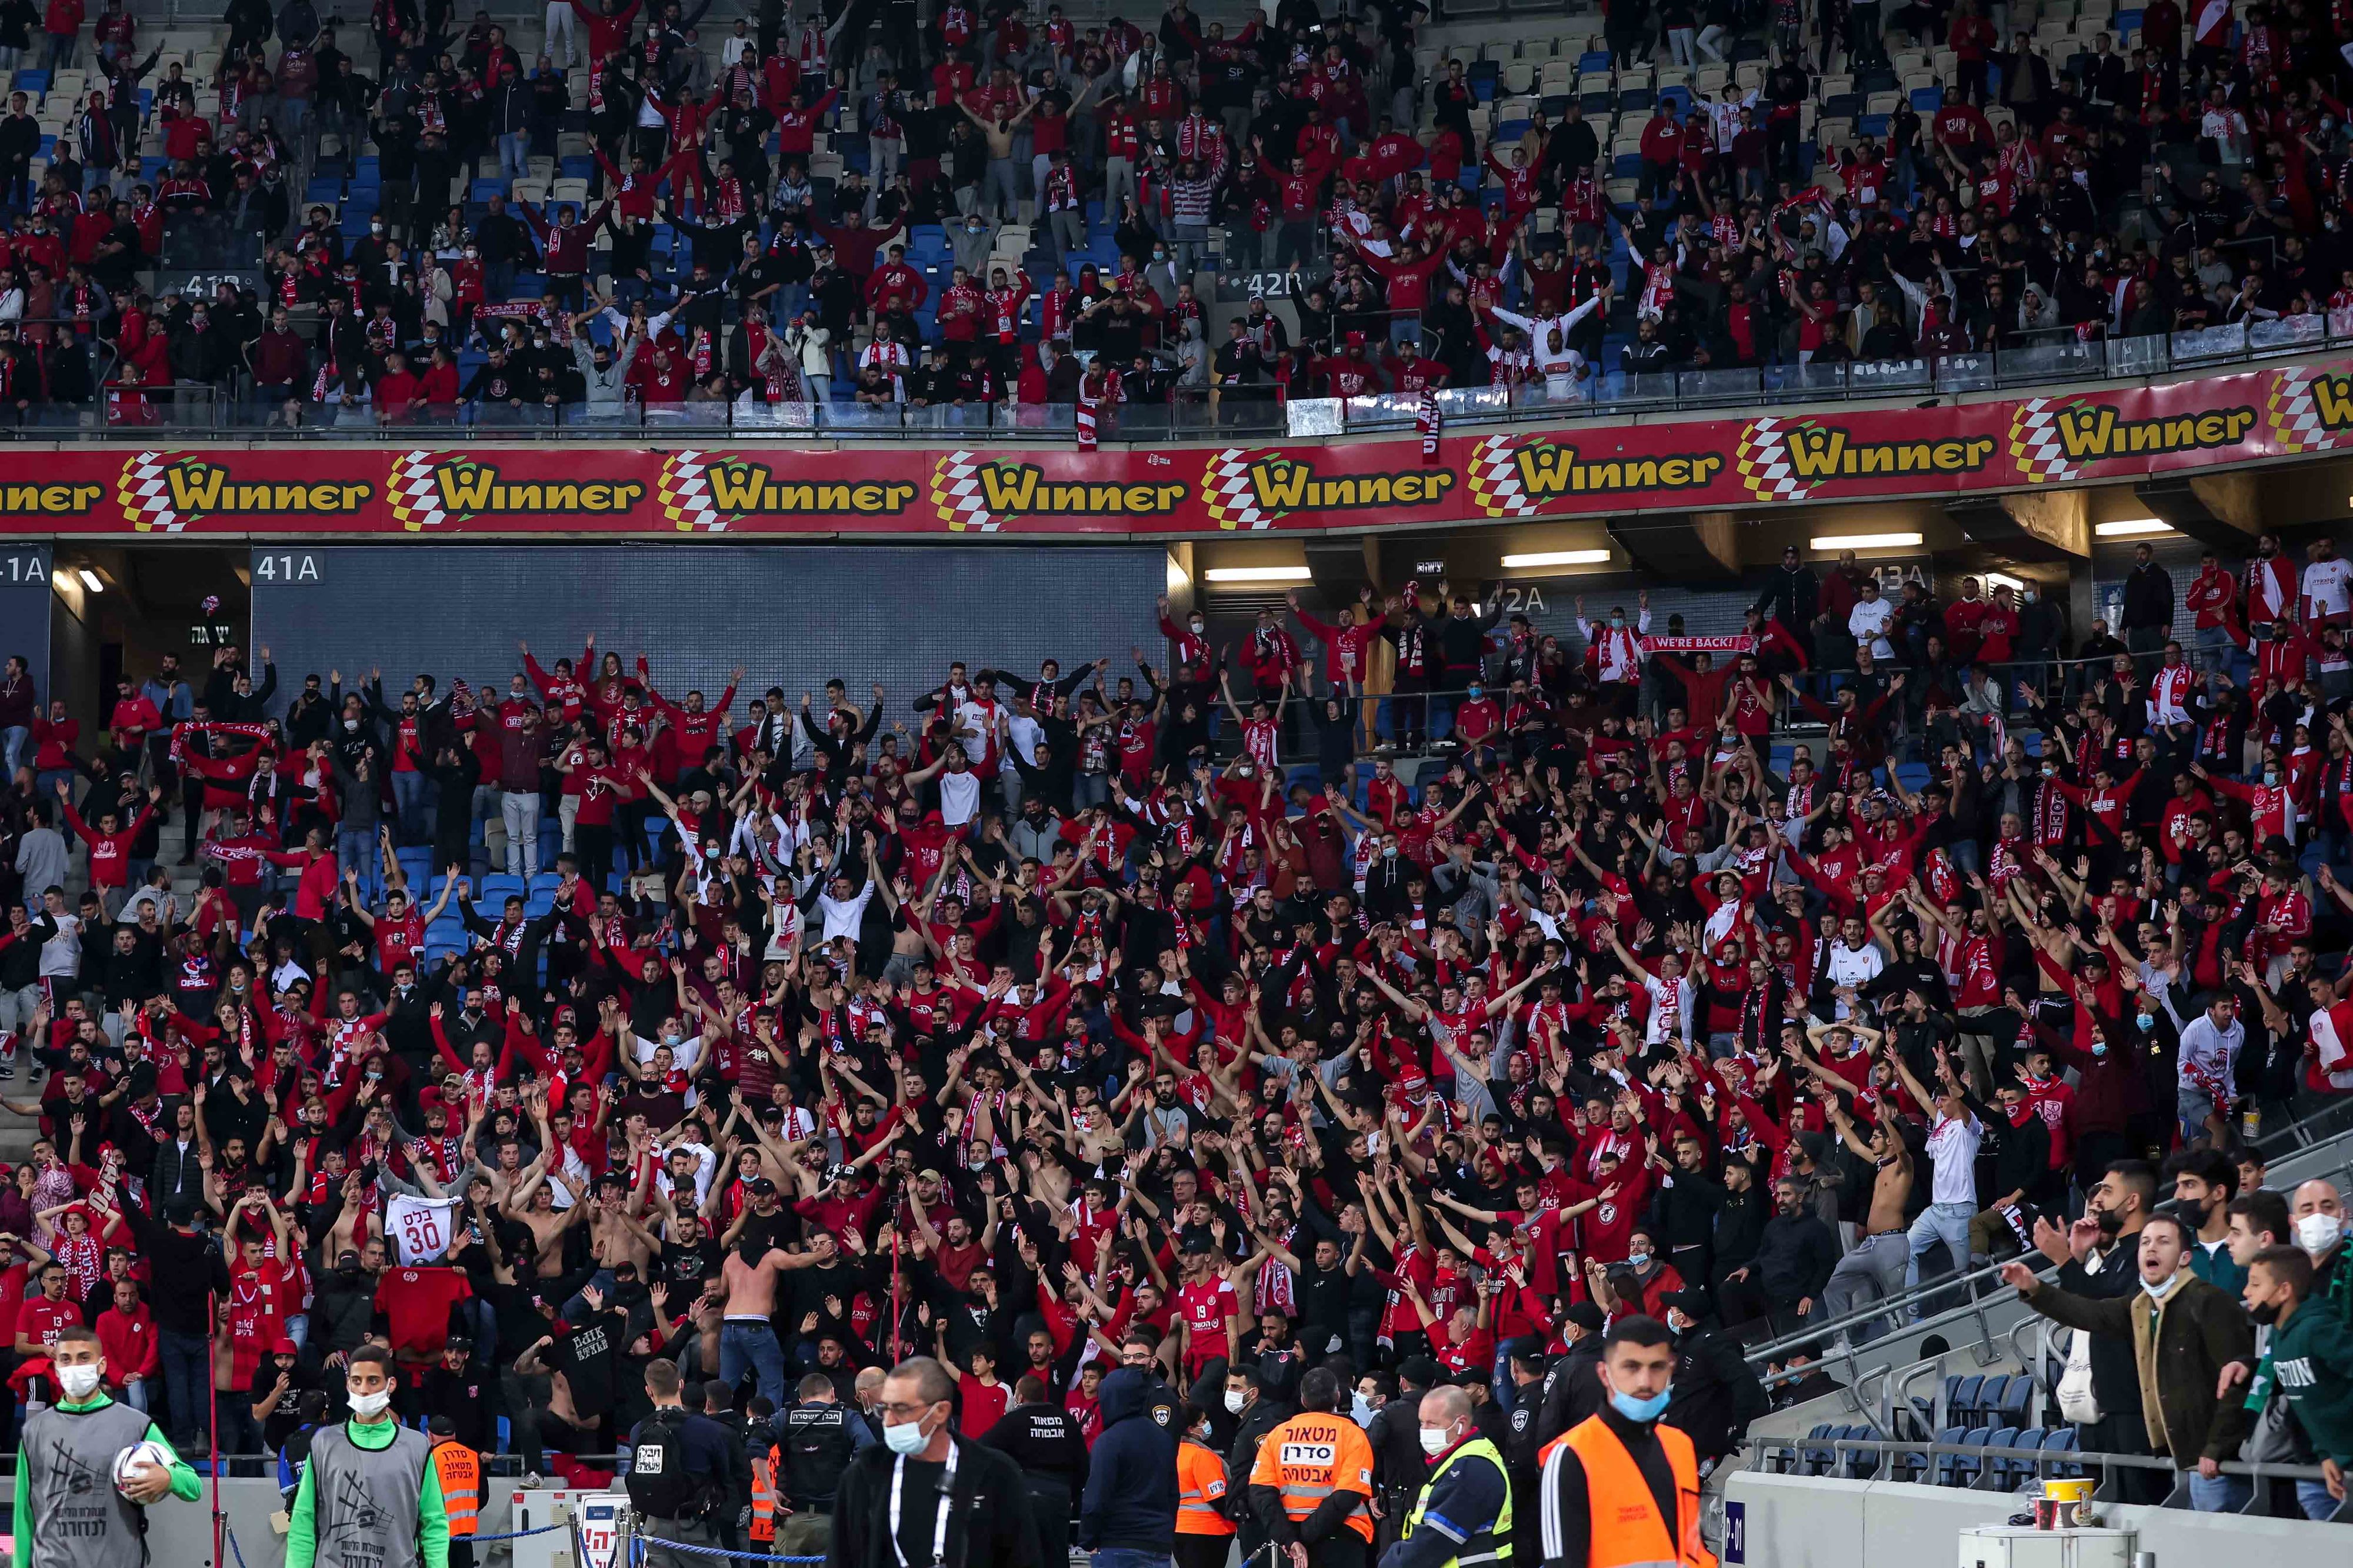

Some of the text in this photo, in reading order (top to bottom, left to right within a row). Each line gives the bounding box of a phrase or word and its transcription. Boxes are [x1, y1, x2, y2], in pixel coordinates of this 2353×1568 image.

[2061, 412, 2252, 455] Winner
[1789, 433, 1992, 475] Winner
[1519, 450, 1719, 492] Winner
[169, 468, 369, 511] Winner
[439, 468, 641, 511] Winner
[711, 468, 912, 511] Winner
[983, 468, 1184, 511] Winner
[1254, 466, 1451, 508] Winner
[0, 486, 99, 511] ner
[0, 556, 45, 582] 1A
[258, 555, 319, 581] 41A
[1869, 565, 1927, 590] 43A
[191, 625, 229, 644] יצאה
[1655, 636, 1732, 649] WE'RE BACK!
[181, 979, 209, 987] OPEL
[1447, 1029, 1467, 1038] ארקי
[747, 1048, 768, 1063] AXA
[1539, 1195, 1559, 1209] arki
[408, 1209, 437, 1227] בלס
[410, 1222, 445, 1255] 30
[1195, 1305, 1205, 1319] 19
[54, 1317, 62, 1327] 13
[236, 1319, 254, 1329] arki
[1030, 1415, 1063, 1426] מטאור
[1030, 1428, 1065, 1439] אבטחה
[1285, 1427, 1336, 1443] מטאור
[442, 1450, 467, 1463] סדרן
[1283, 1446, 1331, 1462] סדרן
[445, 1461, 472, 1472] מטאור
[445, 1470, 474, 1480] אבטחה
[56, 1519, 106, 1537] לכדורגל
